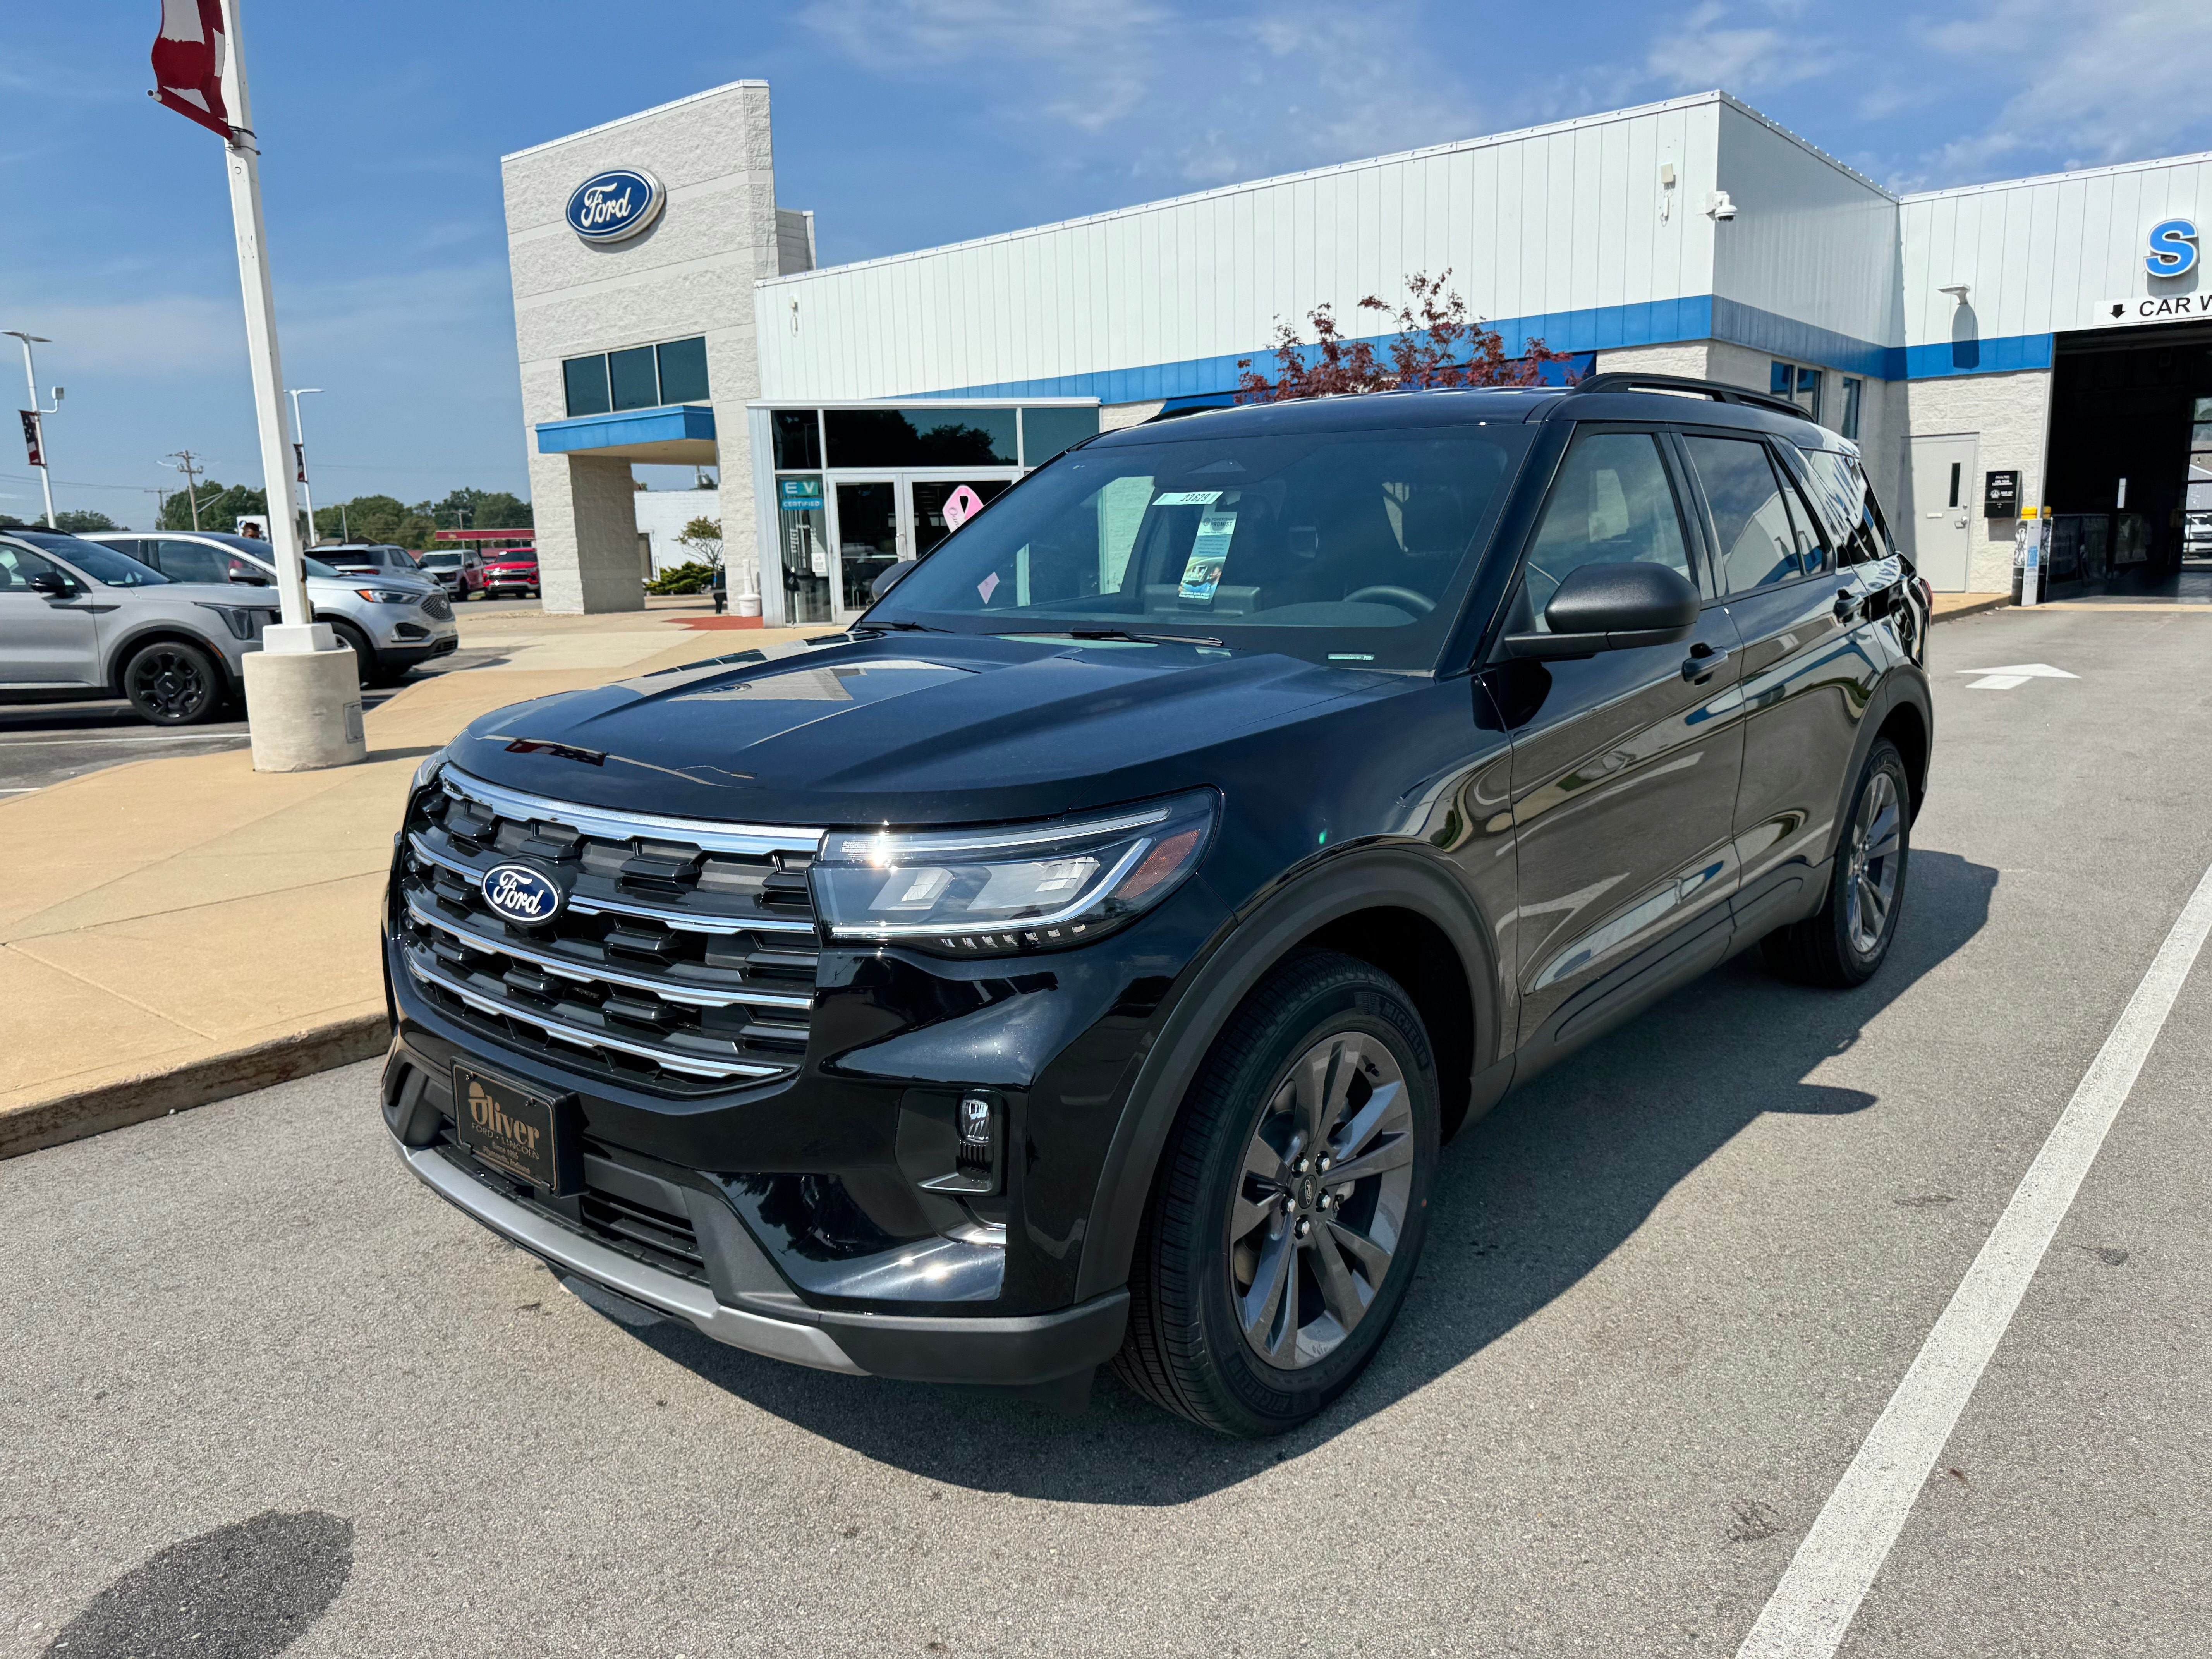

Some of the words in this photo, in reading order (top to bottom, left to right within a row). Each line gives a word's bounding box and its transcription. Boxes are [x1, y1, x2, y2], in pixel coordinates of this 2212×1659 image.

[581, 182, 631, 227] Ford
[2139, 297, 2190, 317] CAR
[785, 481, 814, 494] EV
[1180, 493, 1211, 501] 23629
[493, 871, 544, 915] Ford
[468, 1082, 539, 1149] Oliver
[471, 1122, 494, 1138] FORD
[501, 1136, 539, 1161] LINCOLN
